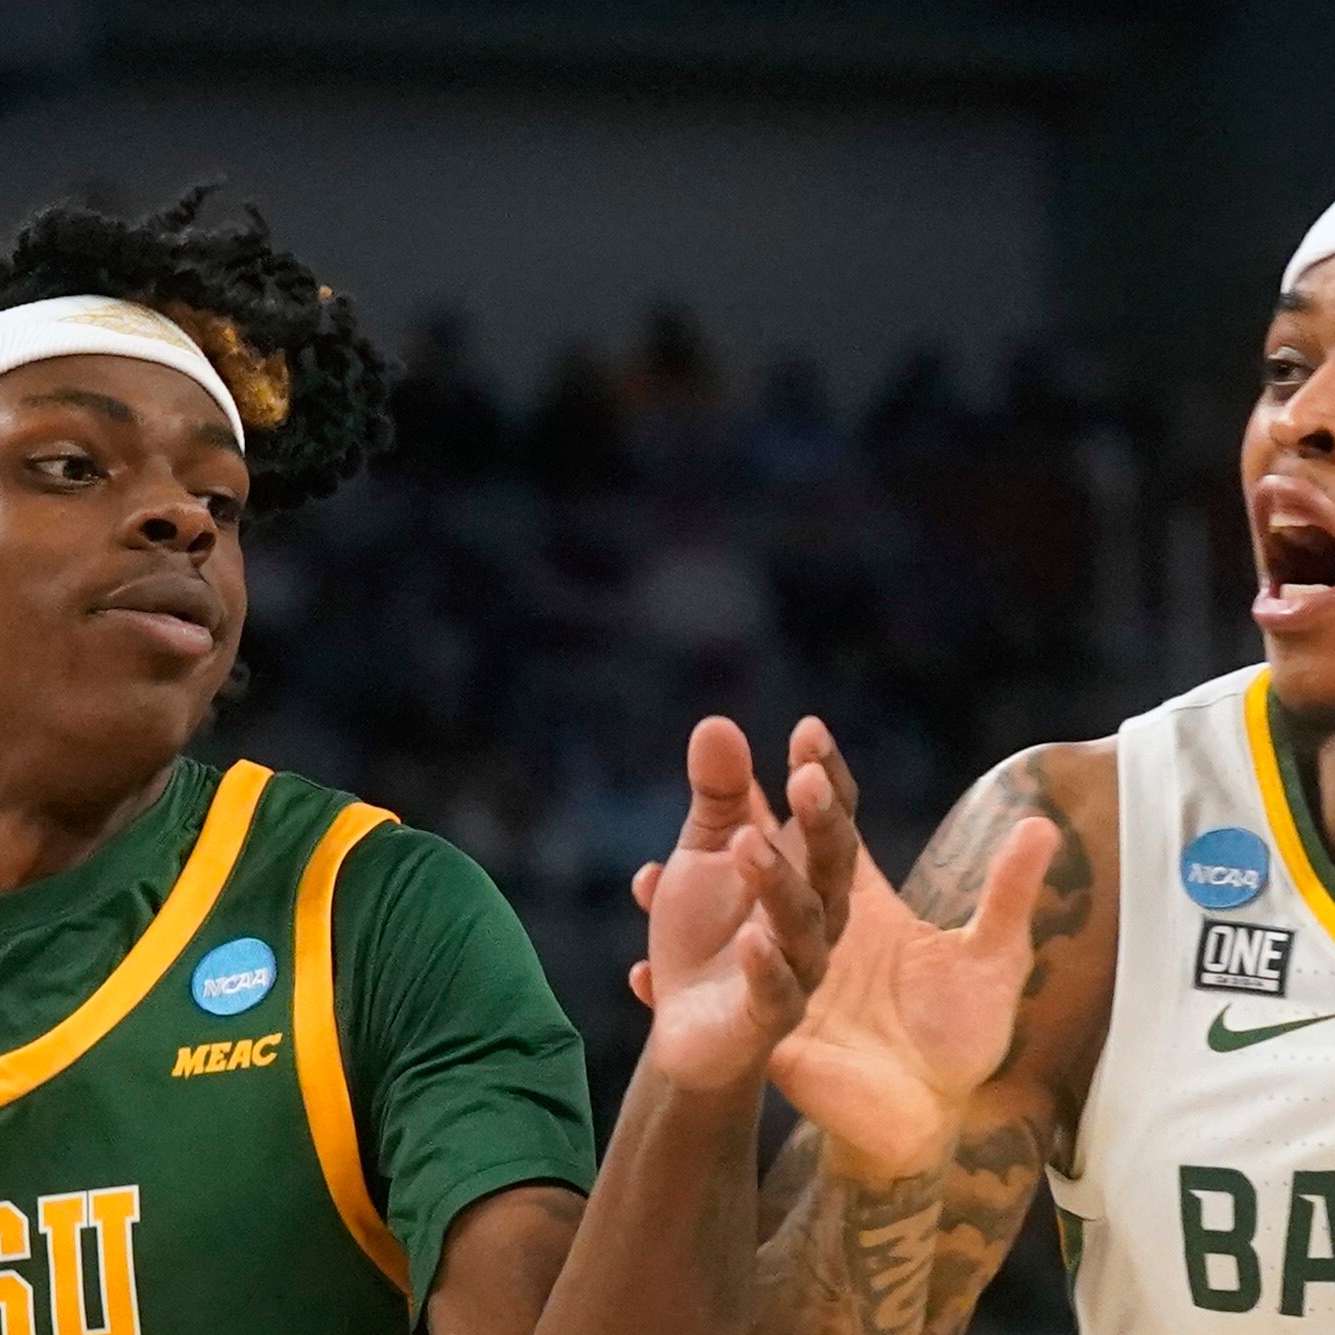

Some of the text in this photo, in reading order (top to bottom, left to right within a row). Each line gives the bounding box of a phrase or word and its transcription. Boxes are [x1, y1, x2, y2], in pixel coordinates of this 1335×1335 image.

[1188, 863, 1259, 890] NCAA
[1202, 925, 1289, 979] ONE
[202, 967, 270, 998] NCAA
[171, 1032, 284, 1080] MEAC
